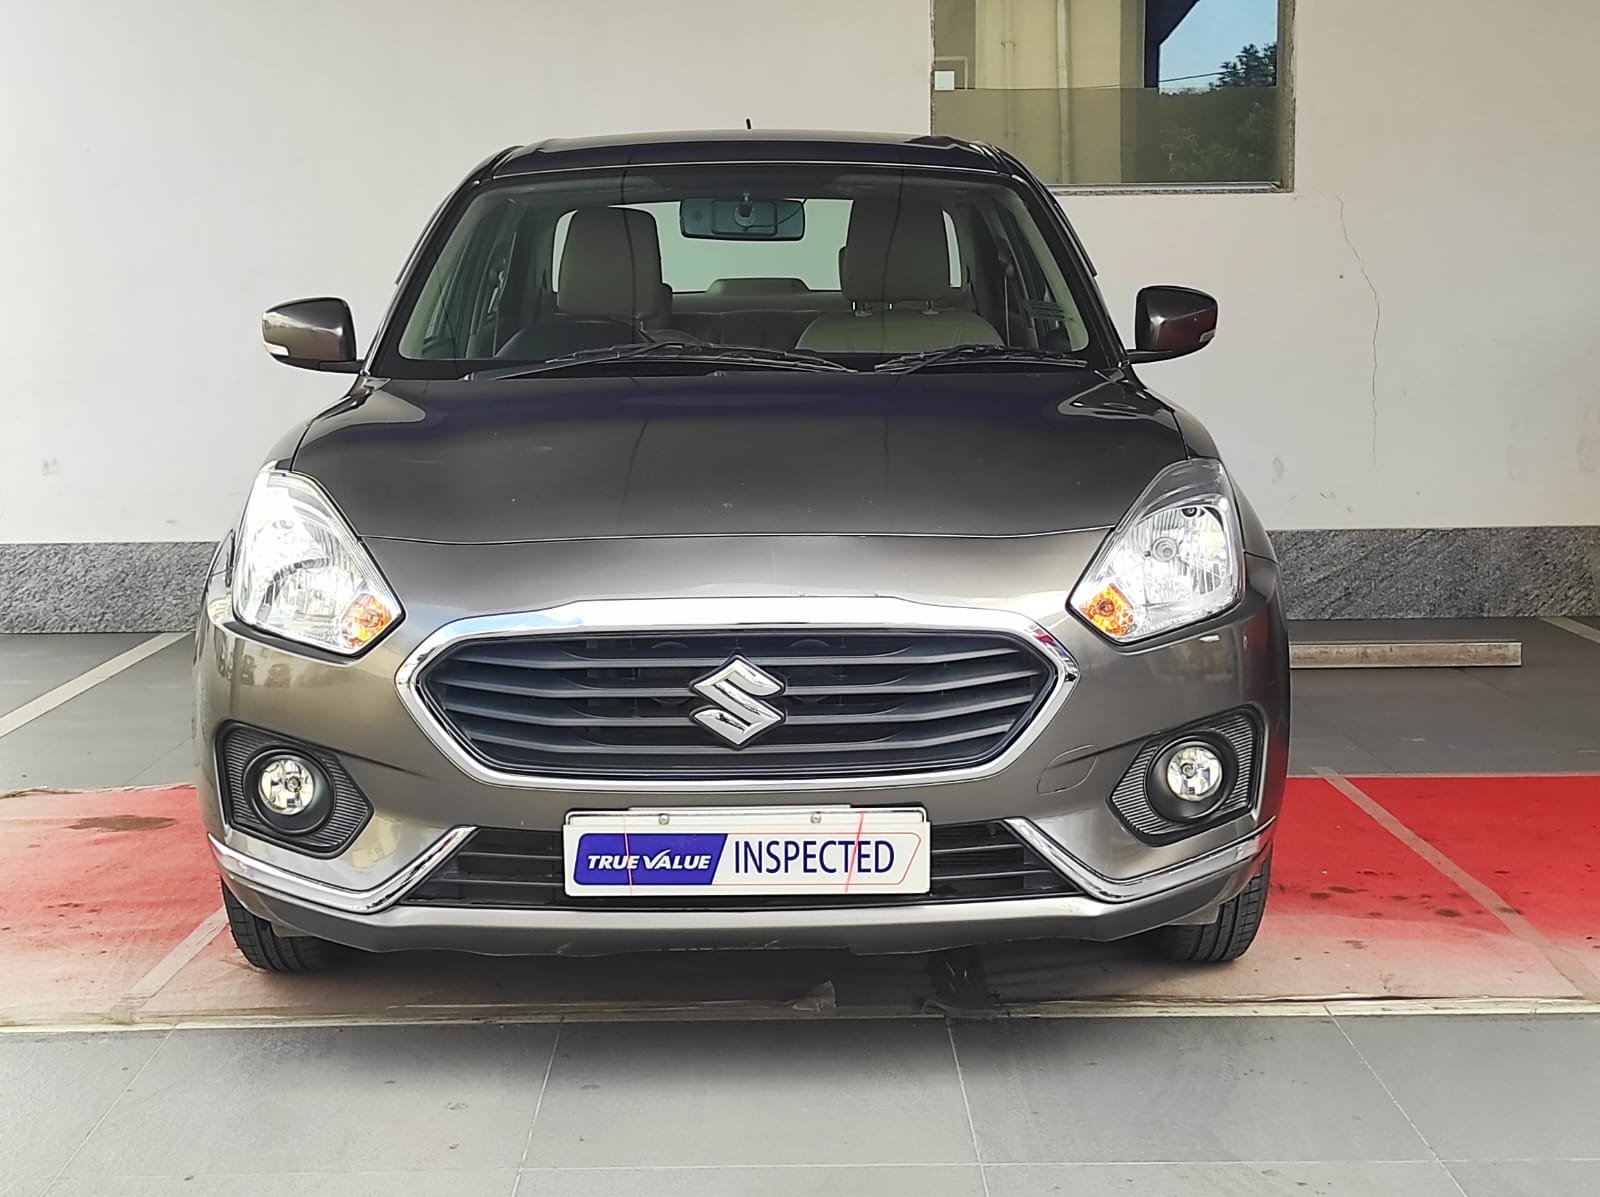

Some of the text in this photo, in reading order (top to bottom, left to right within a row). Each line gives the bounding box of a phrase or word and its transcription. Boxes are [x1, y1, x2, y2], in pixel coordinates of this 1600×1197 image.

[587, 839, 895, 874] TRUE VALUE INSPECTED
